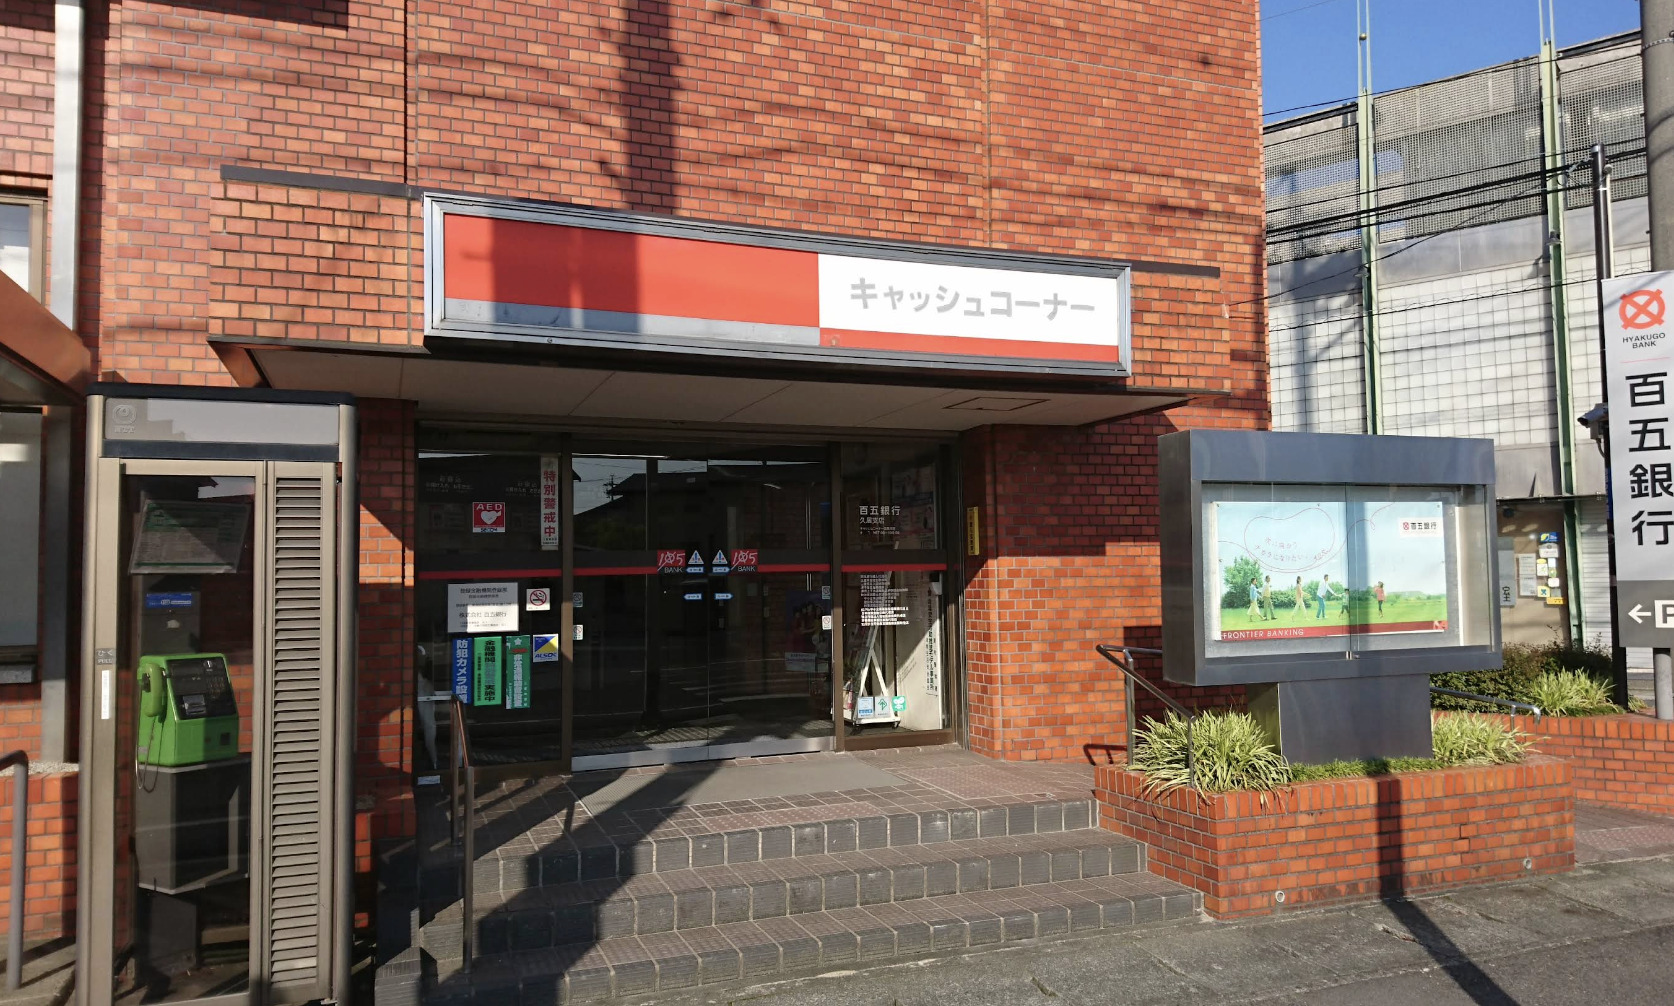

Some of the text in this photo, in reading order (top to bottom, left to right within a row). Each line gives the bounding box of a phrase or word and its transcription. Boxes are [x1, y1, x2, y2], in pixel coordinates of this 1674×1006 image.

[850, 277, 1096, 322] キャッシュコーナー
[1622, 333, 1666, 343] HYAKUGO
[1632, 341, 1657, 349] BANK
[1625, 371, 1674, 546] 百五銀行
[476, 503, 503, 511] AED
[543, 470, 557, 537] 特別警戒中
[859, 505, 901, 516] 百五銀行
[1223, 628, 1304, 639] FRONTIER BANKING
